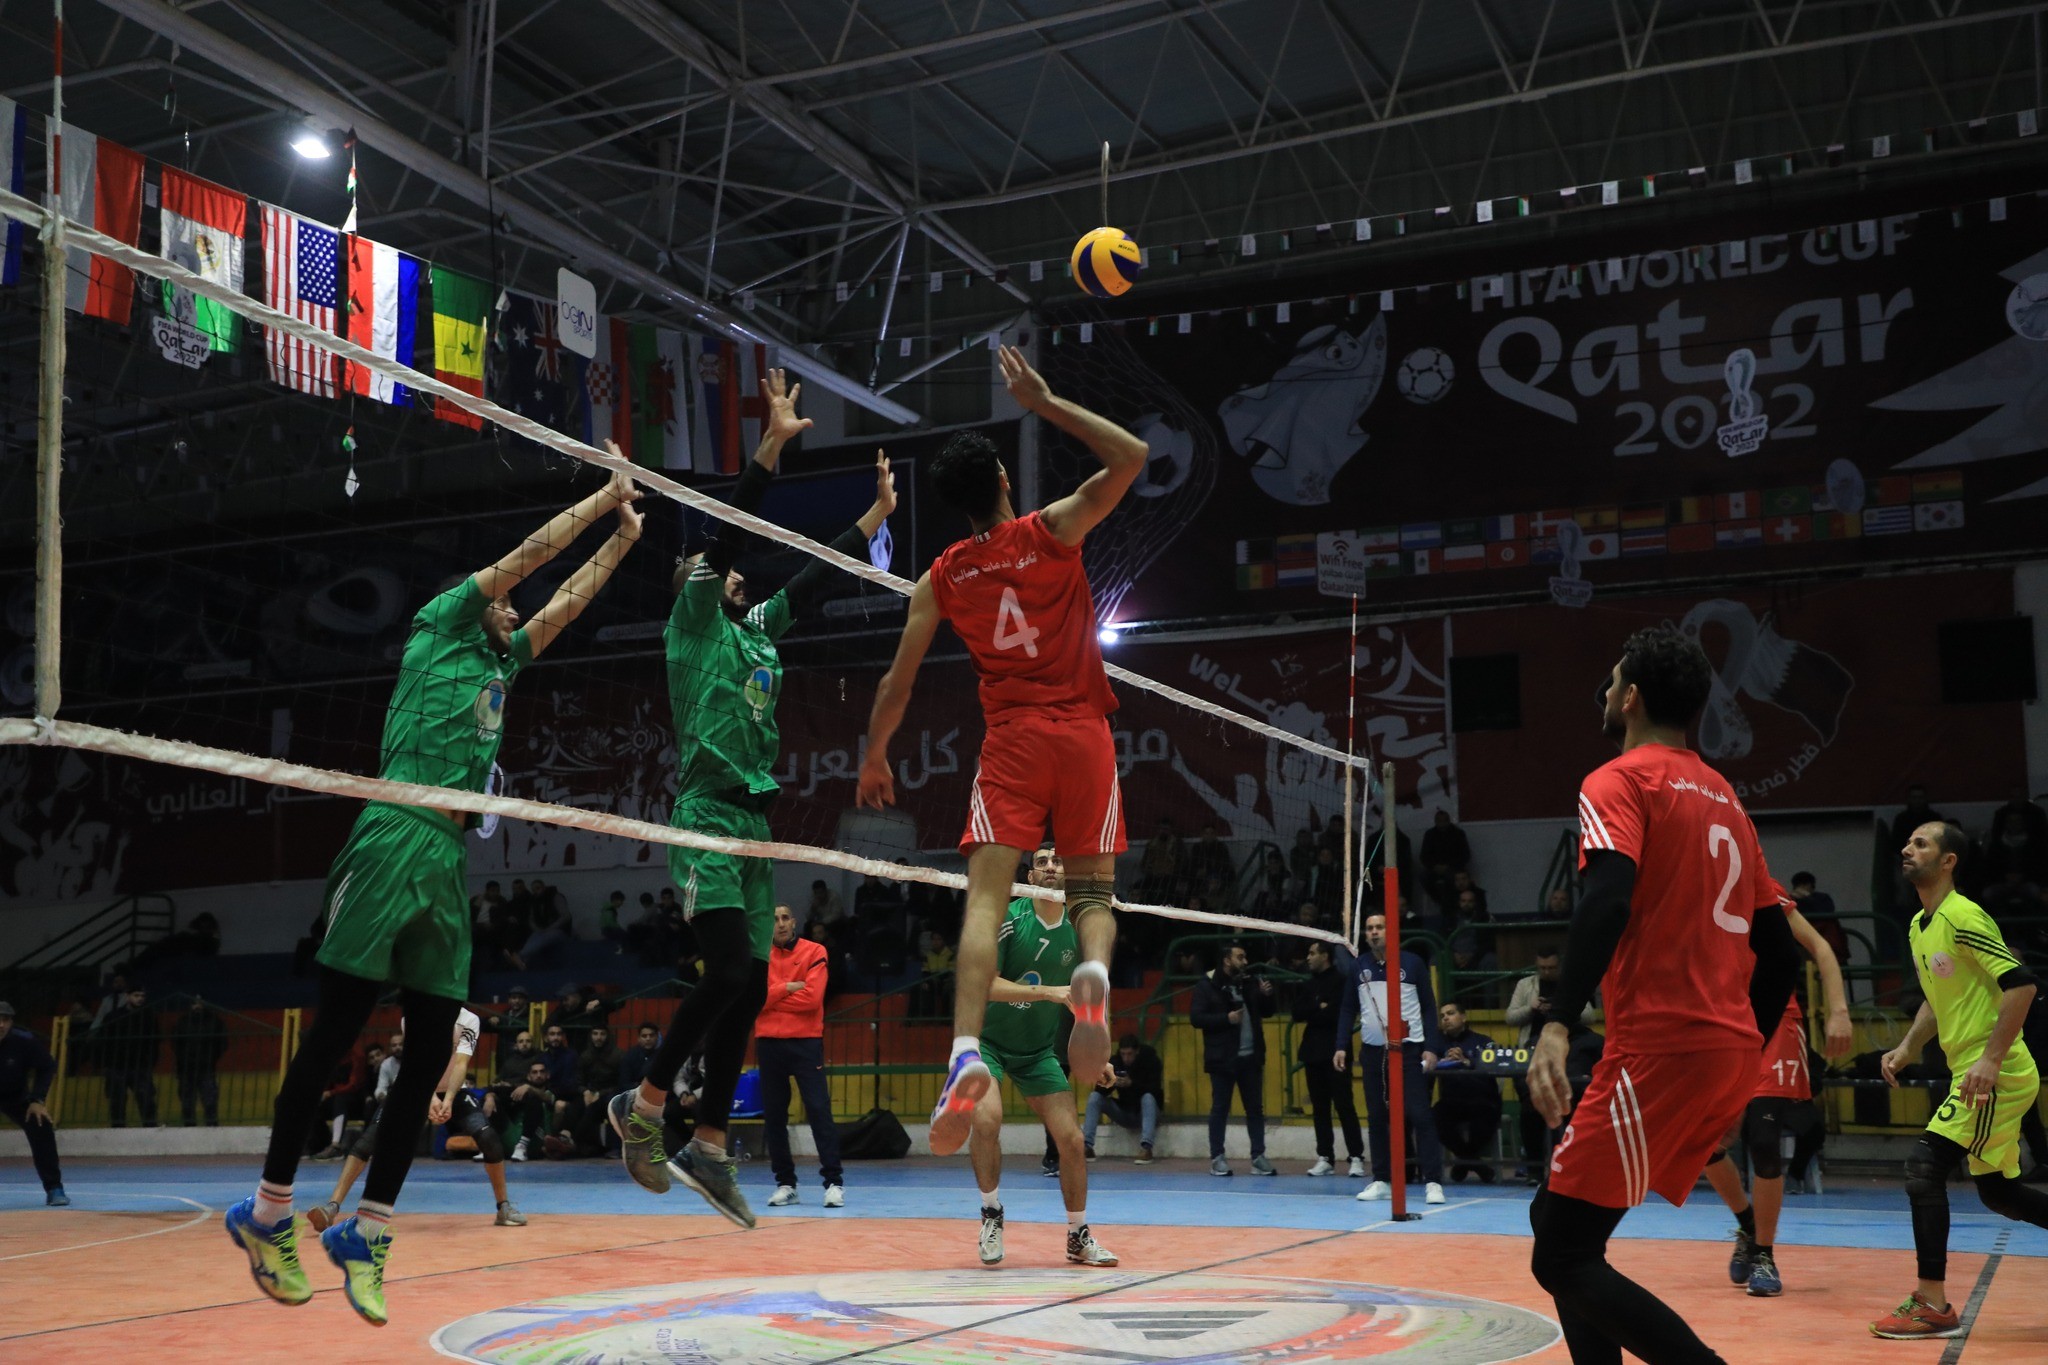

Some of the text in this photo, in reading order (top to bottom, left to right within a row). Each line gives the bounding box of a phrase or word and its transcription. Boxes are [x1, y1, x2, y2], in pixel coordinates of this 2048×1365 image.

[1471, 211, 1920, 312] FIFA WORLD CUP
[159, 329, 207, 358] Qatar
[173, 349, 197, 365] 2022
[1478, 288, 1914, 424] Qatar
[1722, 427, 1765, 449] Qatar
[1342, 556, 1364, 570] Free
[993, 586, 1040, 658] 4
[901, 727, 960, 790] كل
[1751, 769, 1789, 798] في
[1708, 823, 1750, 934] 2
[1034, 937, 1050, 962] 7
[1481, 1048, 1495, 1064] 0
[1514, 1048, 1529, 1064] 0
[1772, 1058, 1800, 1086] 17
[1937, 1094, 1960, 1122] 5
[1550, 1124, 1575, 1173] 2
